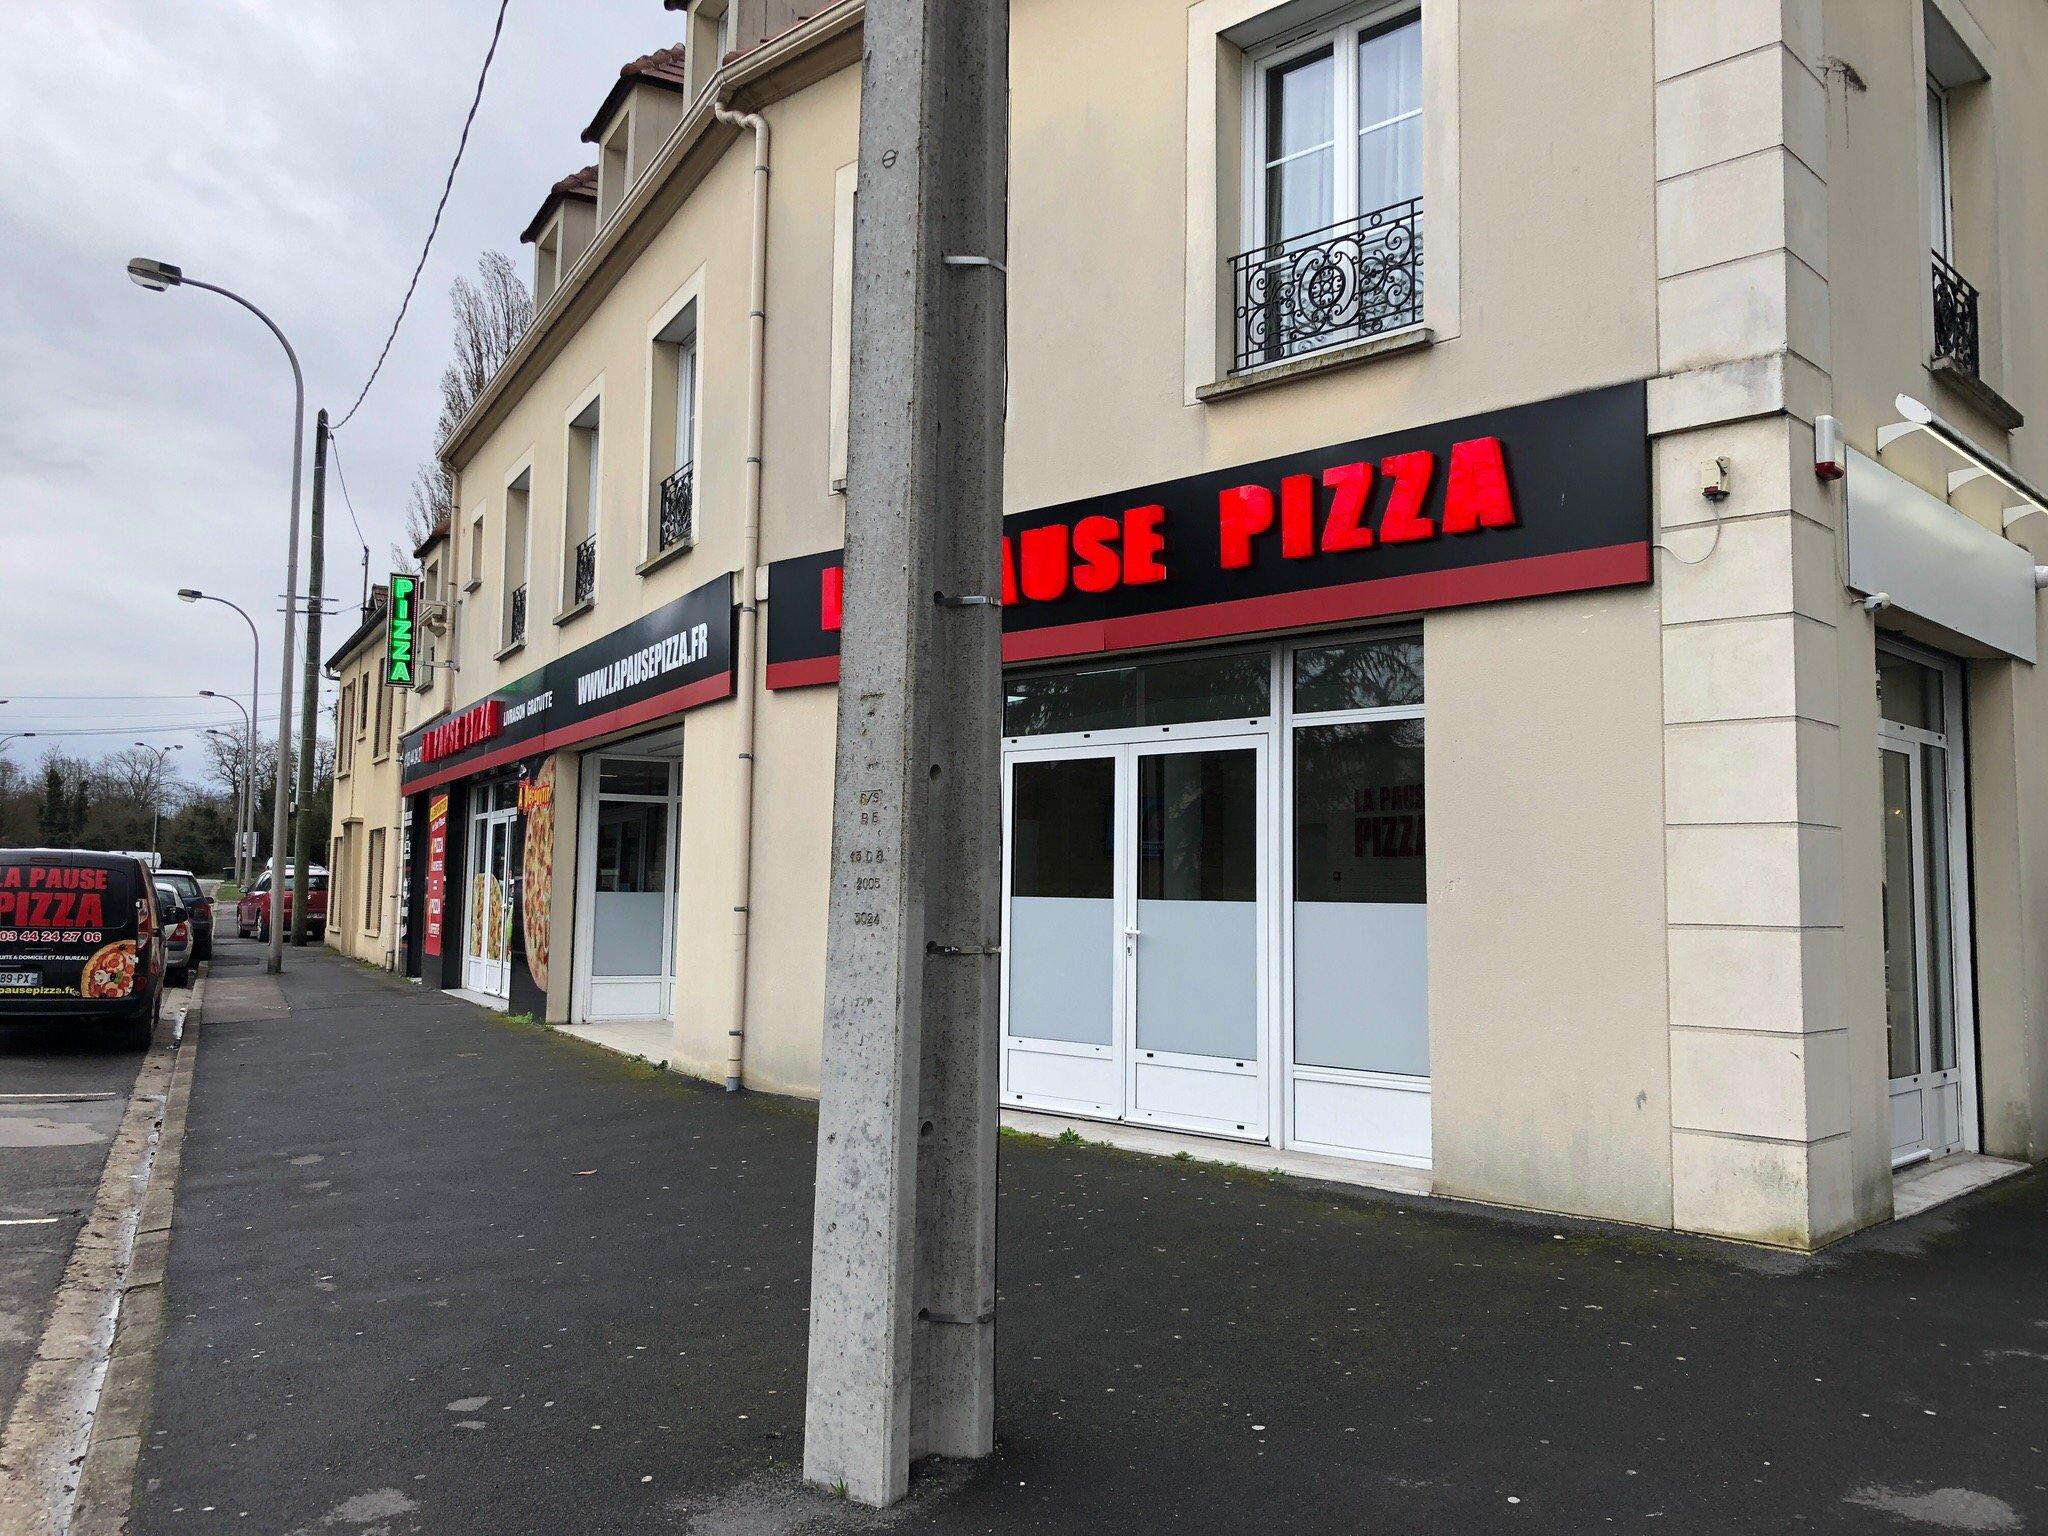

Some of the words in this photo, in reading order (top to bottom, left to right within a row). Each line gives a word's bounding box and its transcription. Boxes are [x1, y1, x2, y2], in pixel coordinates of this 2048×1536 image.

[1001, 504, 1167, 606] USE
[1219, 436, 1516, 570] PIZZA
[391, 579, 414, 681] PIZZA
[578, 622, 708, 706] WWW.LAPAUSEPIZZA.FR
[29, 867, 108, 890] PAUSE
[0, 930, 18, 942] 03
[20, 930, 39, 942] 44
[41, 931, 60, 942] 24
[62, 931, 81, 943] 27
[83, 931, 102, 943] 06
